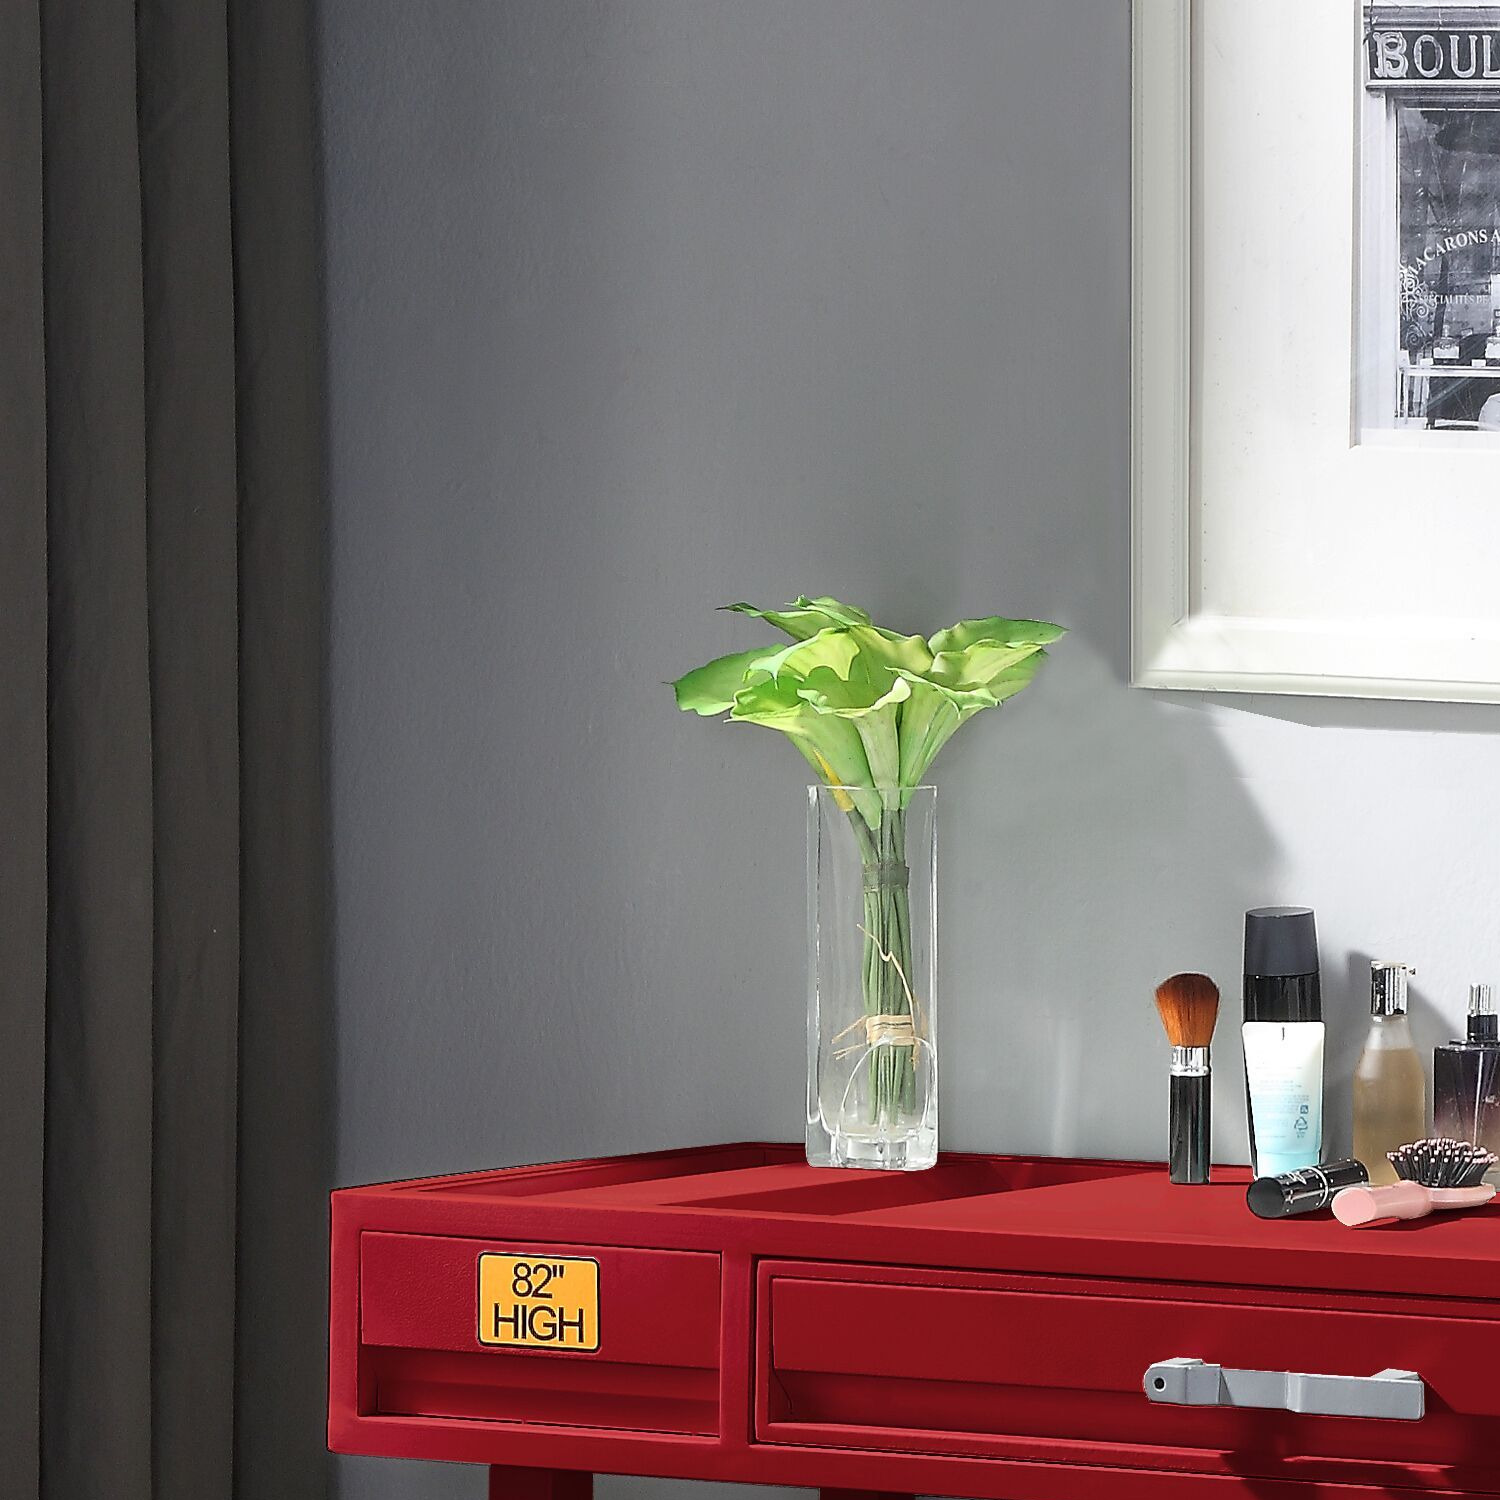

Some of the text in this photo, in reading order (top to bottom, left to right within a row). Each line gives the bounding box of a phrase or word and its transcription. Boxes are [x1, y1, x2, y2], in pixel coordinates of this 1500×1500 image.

[1491, 229, 1500, 243] A
[1420, 292, 1475, 305] CIALITÉS
[512, 1262, 565, 1299] 82"
[493, 1302, 585, 1344] HIGH
